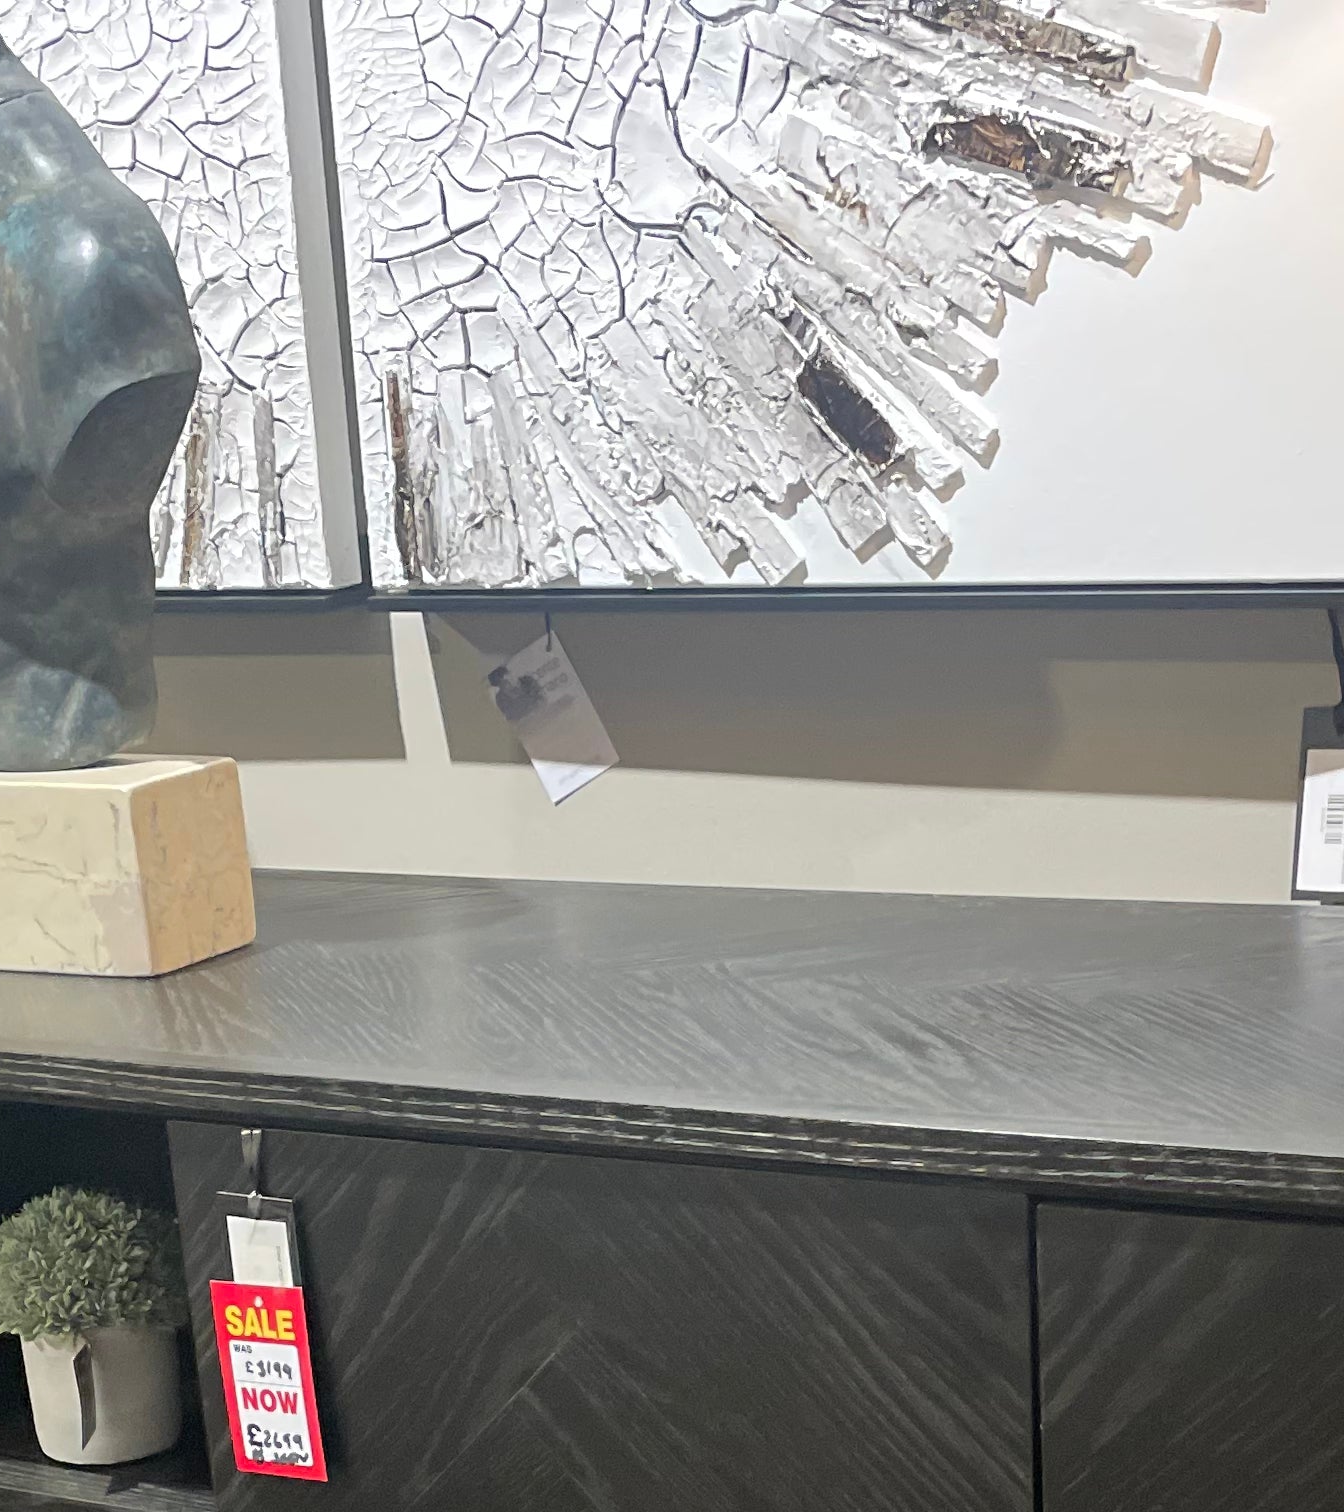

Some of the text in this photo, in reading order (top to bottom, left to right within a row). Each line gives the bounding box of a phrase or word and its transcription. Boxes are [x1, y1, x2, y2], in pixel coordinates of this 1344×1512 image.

[224, 1304, 296, 1341] SALE
[232, 1344, 253, 1355] WAS
[241, 1387, 298, 1415] NOW
[247, 1423, 304, 1451] £2699
